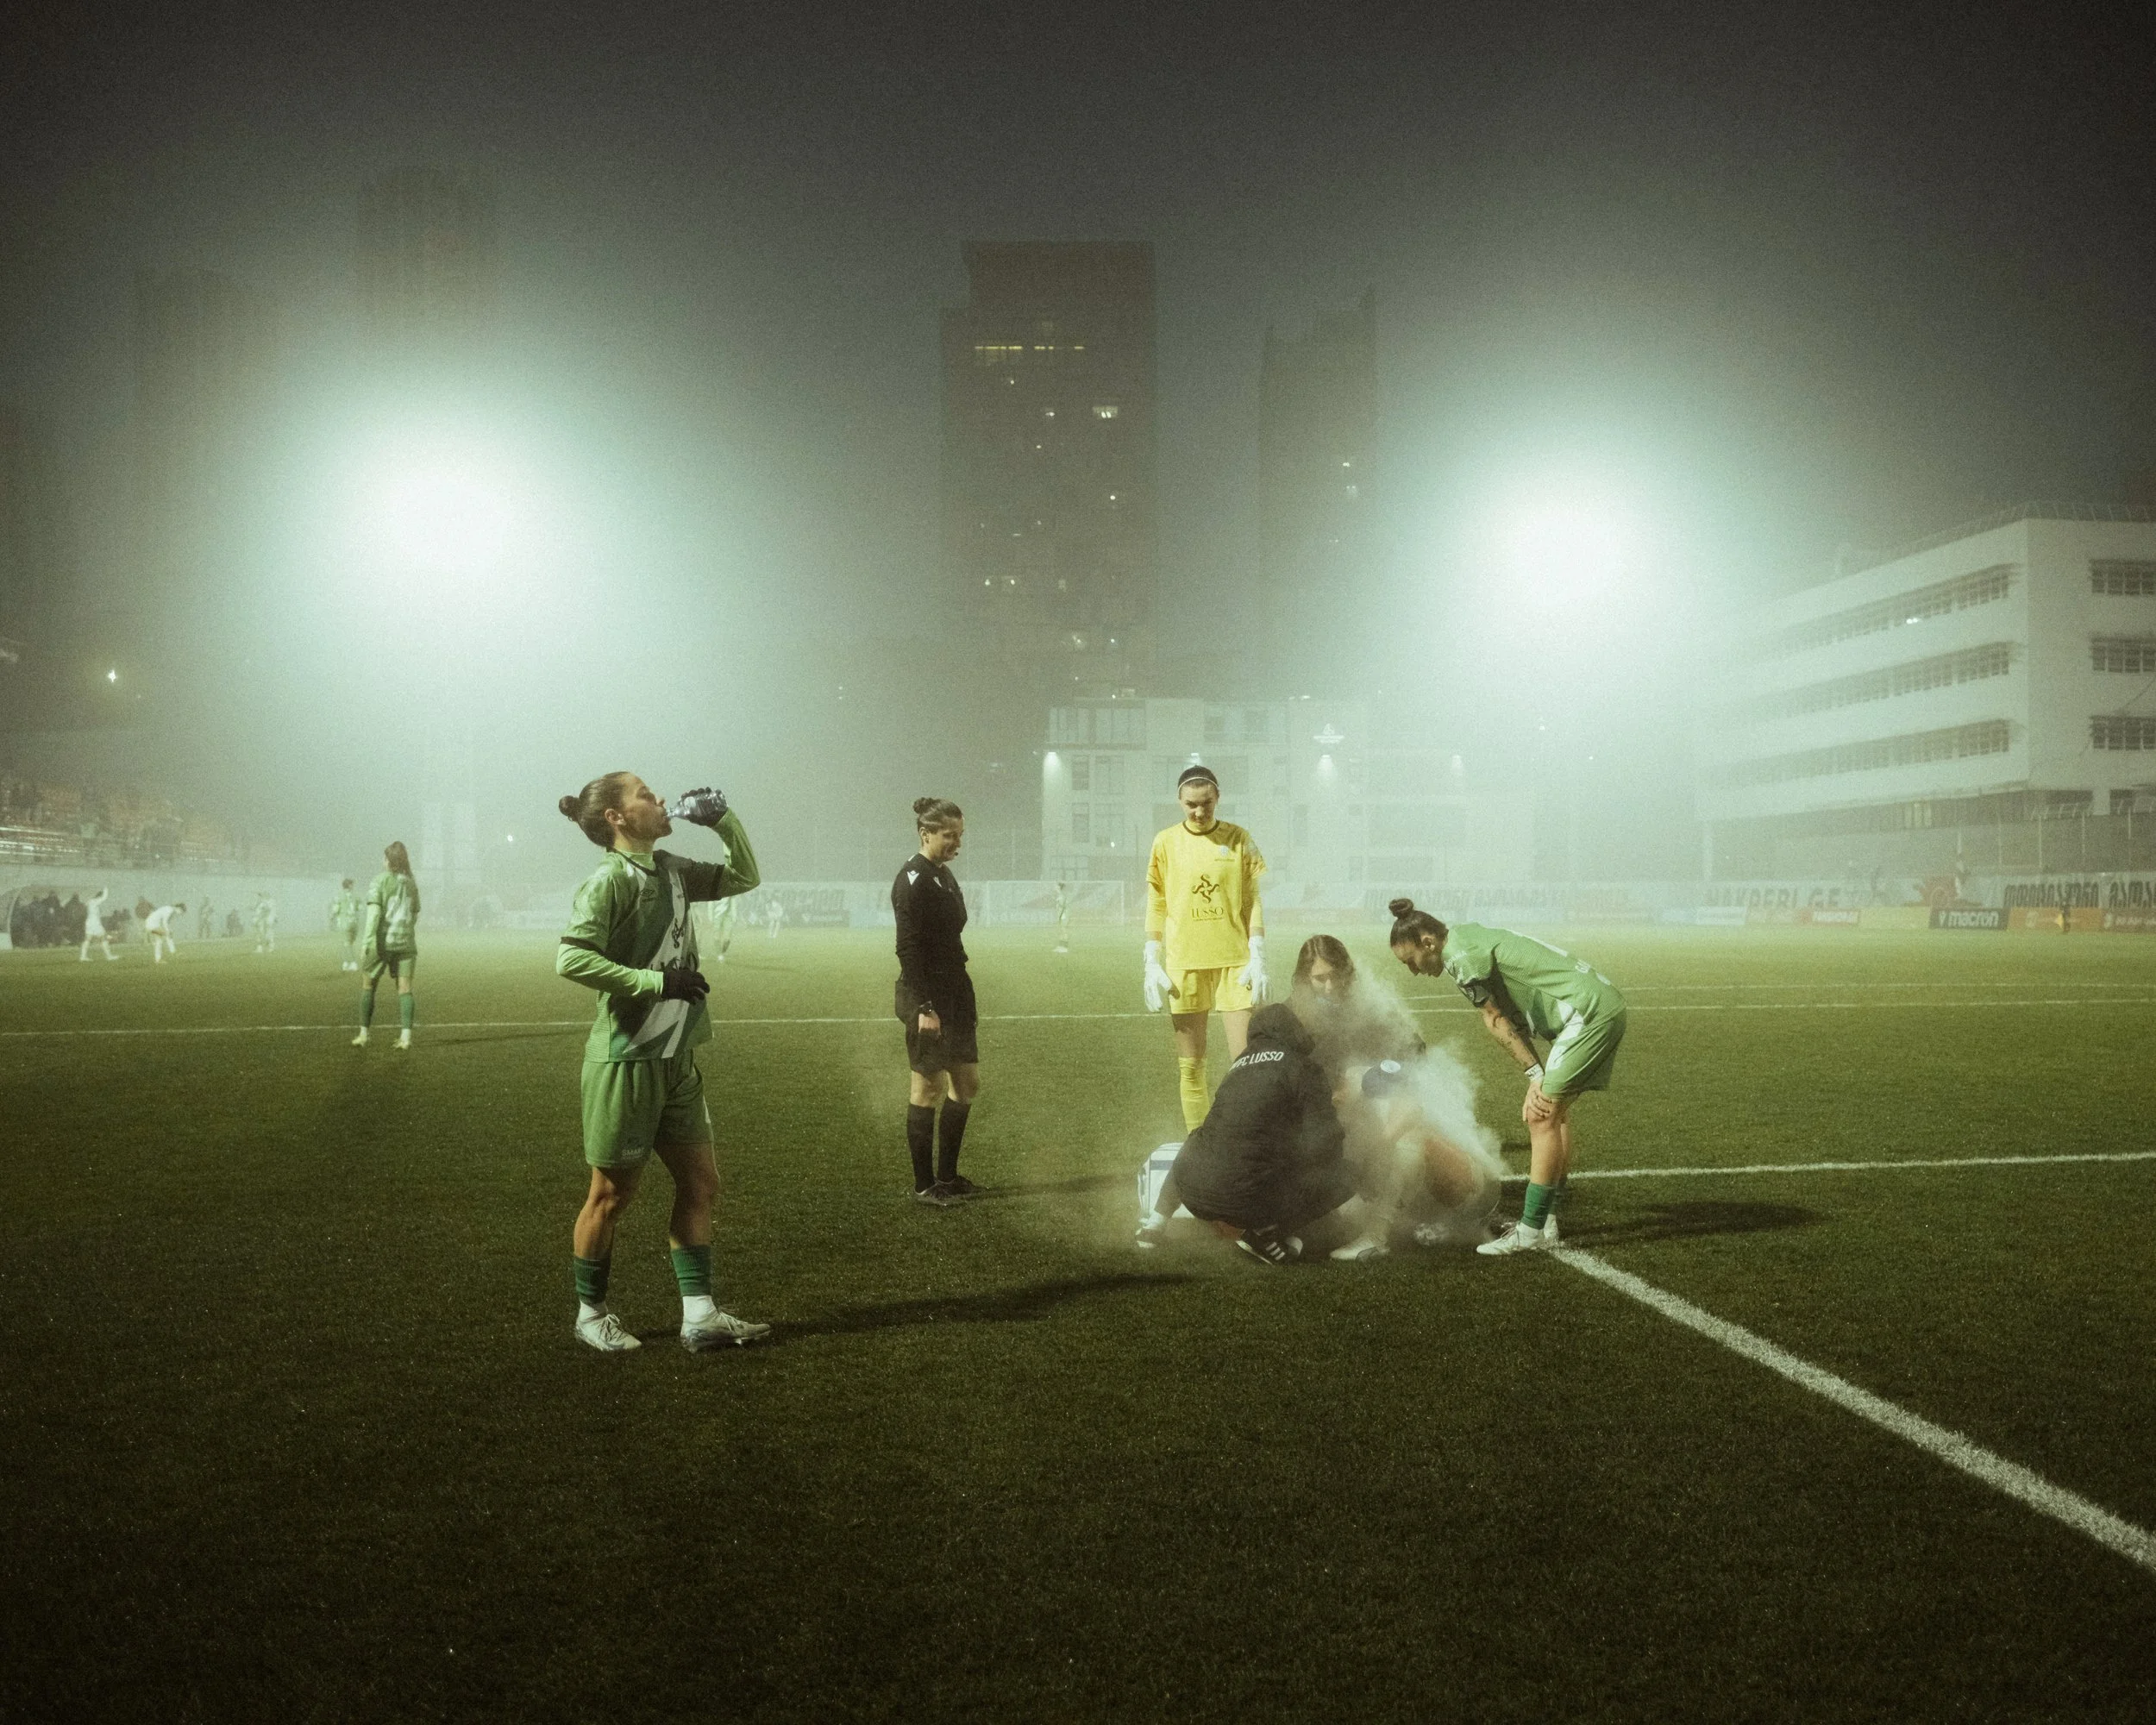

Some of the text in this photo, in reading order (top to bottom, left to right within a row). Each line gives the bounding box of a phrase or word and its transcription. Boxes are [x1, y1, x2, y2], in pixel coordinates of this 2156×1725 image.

[1192, 906, 1224, 918] LUSSO
[1948, 911, 1999, 927] macron
[1249, 1051, 1284, 1064] LUSSO
